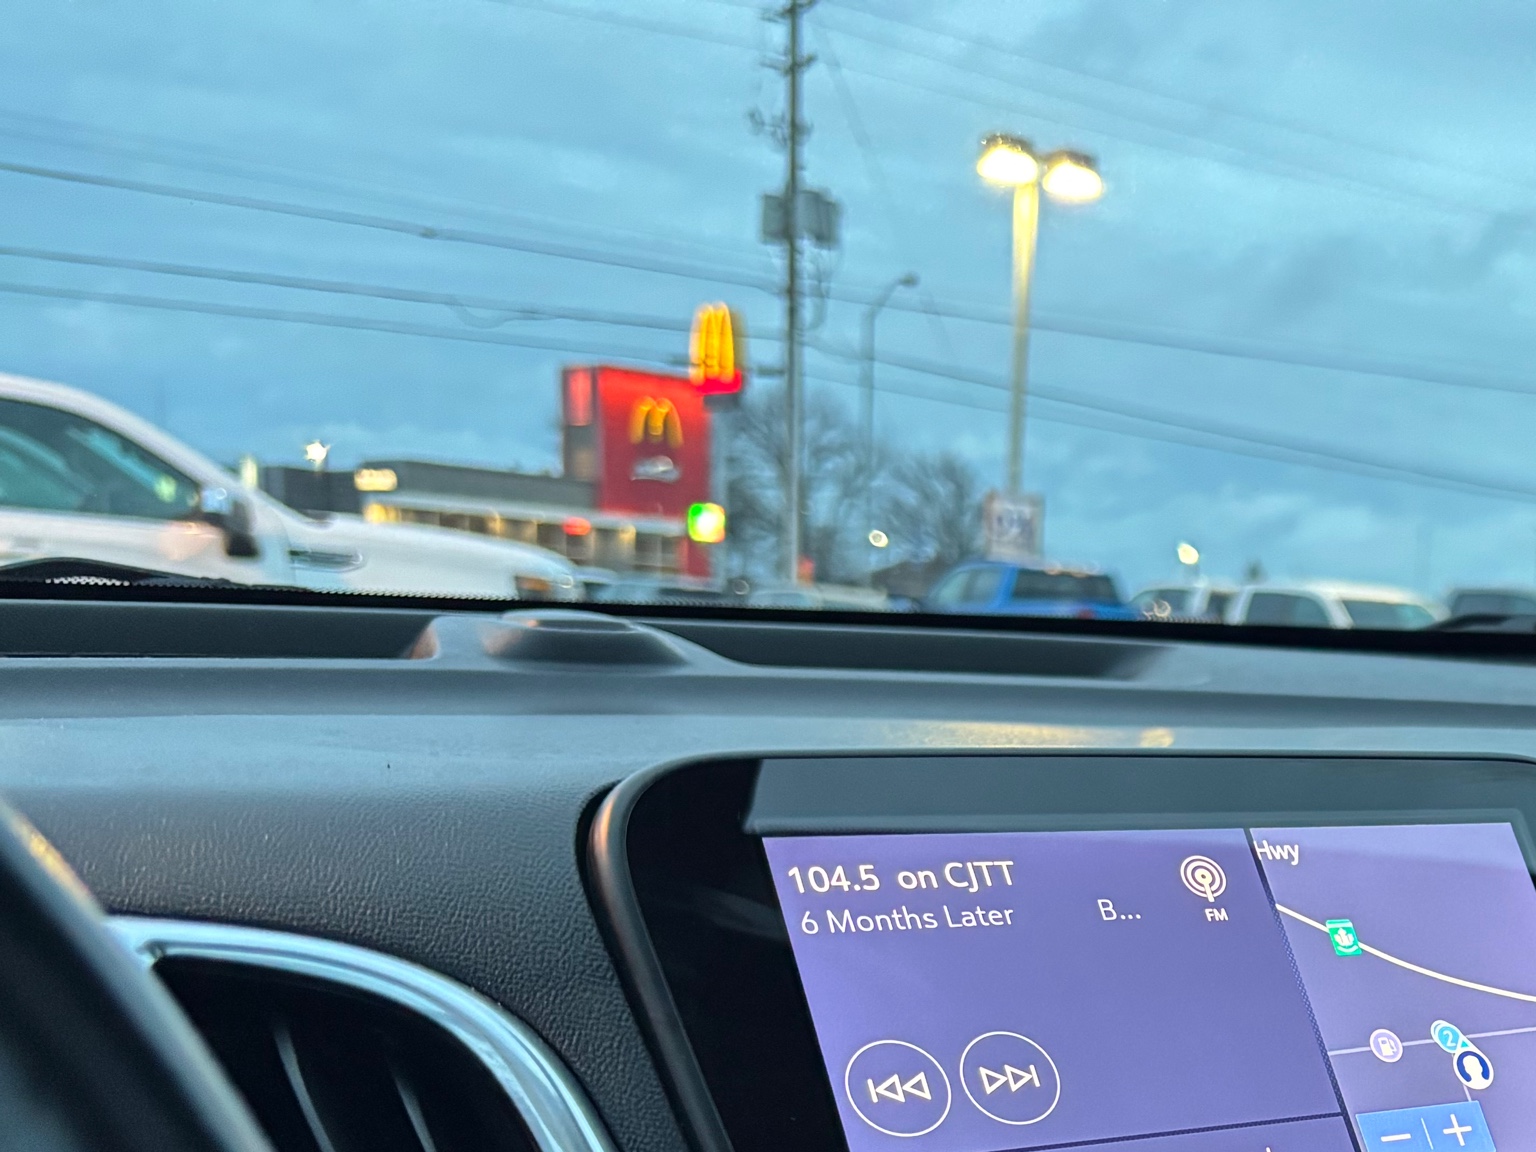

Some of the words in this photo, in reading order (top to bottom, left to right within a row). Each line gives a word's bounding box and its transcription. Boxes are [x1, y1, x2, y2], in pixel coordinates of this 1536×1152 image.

[1254, 840, 1299, 866] Hwy
[788, 865, 880, 893] 104.5
[897, 871, 939, 889] on
[944, 861, 1014, 892] CJTT
[802, 911, 819, 935] 6
[827, 906, 939, 934] Months
[943, 905, 1014, 928] Later
[1205, 908, 1229, 922] FM
[1442, 1029, 1457, 1048] 2
